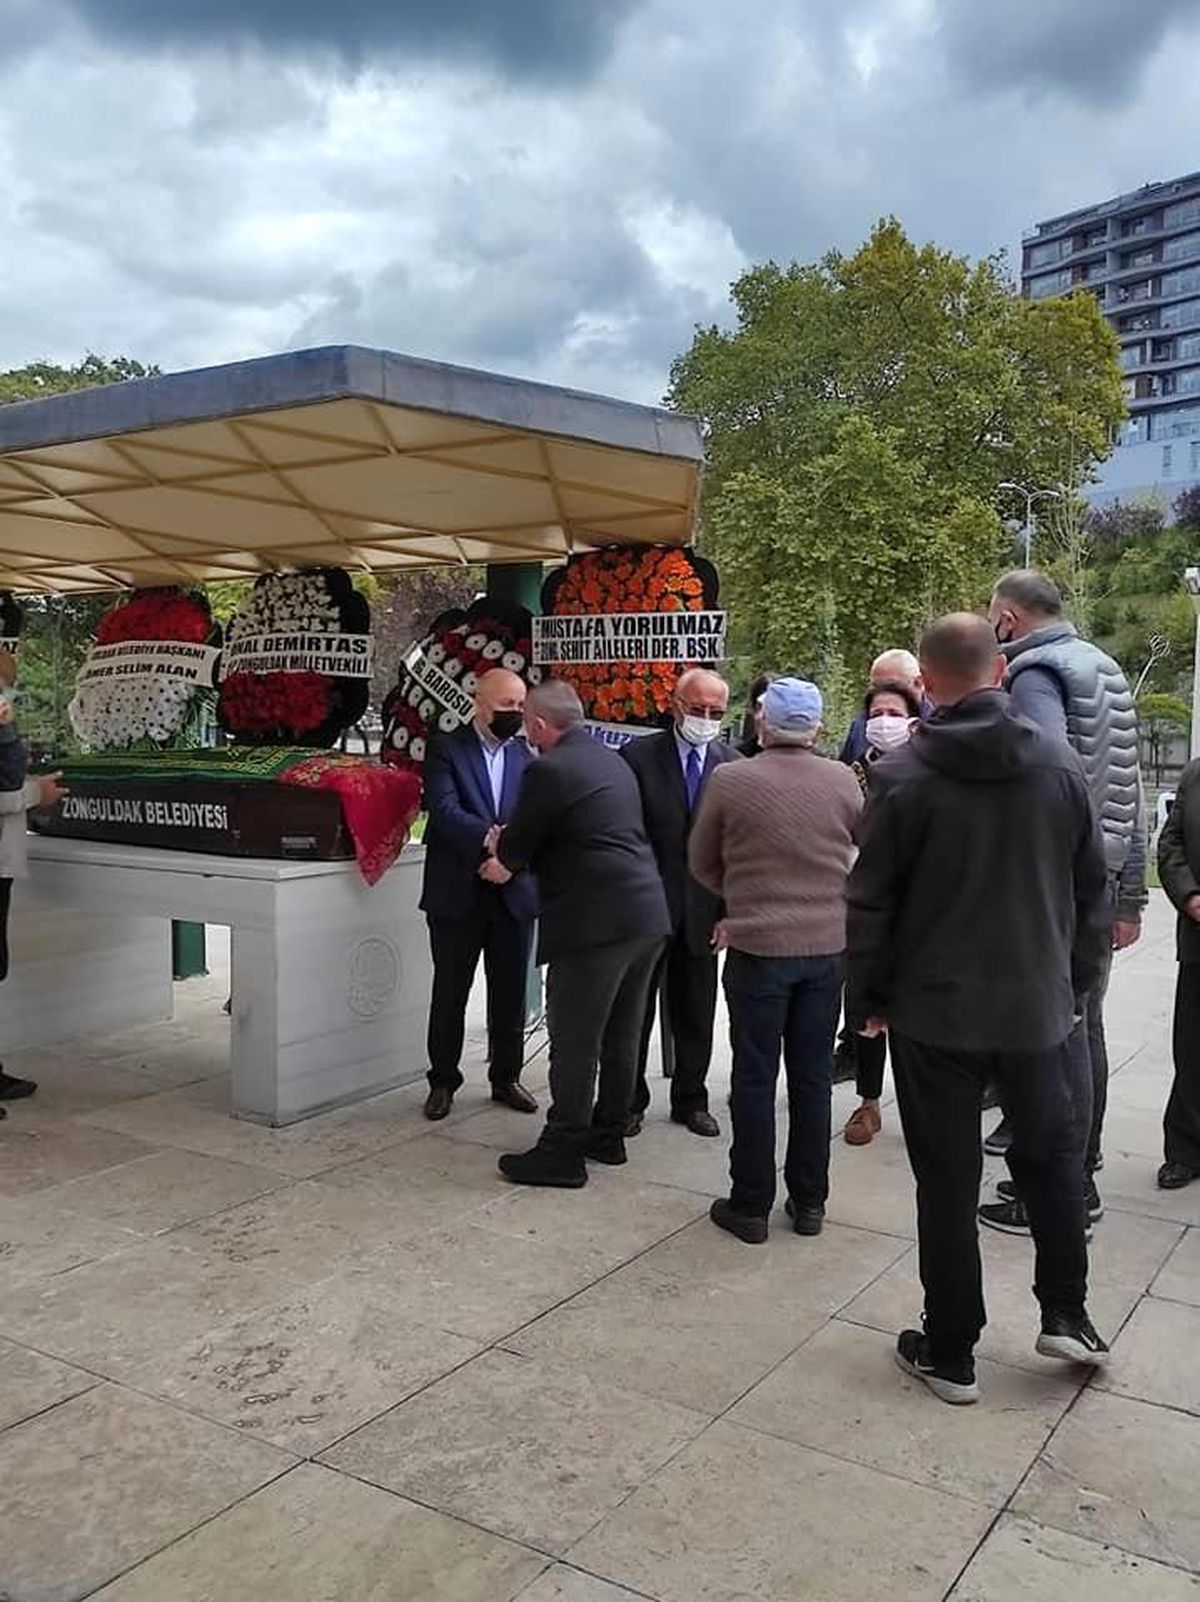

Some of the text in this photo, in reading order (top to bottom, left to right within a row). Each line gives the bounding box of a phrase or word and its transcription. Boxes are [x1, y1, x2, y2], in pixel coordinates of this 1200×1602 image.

[541, 614, 724, 638] MUSTAFA YORULMAZ
[652, 638, 683, 658] DER.
[115, 663, 152, 675] SELİM
[155, 664, 197, 679] ALAN
[424, 668, 473, 717] BAROSU
[62, 797, 144, 824] ZONGULDAK
